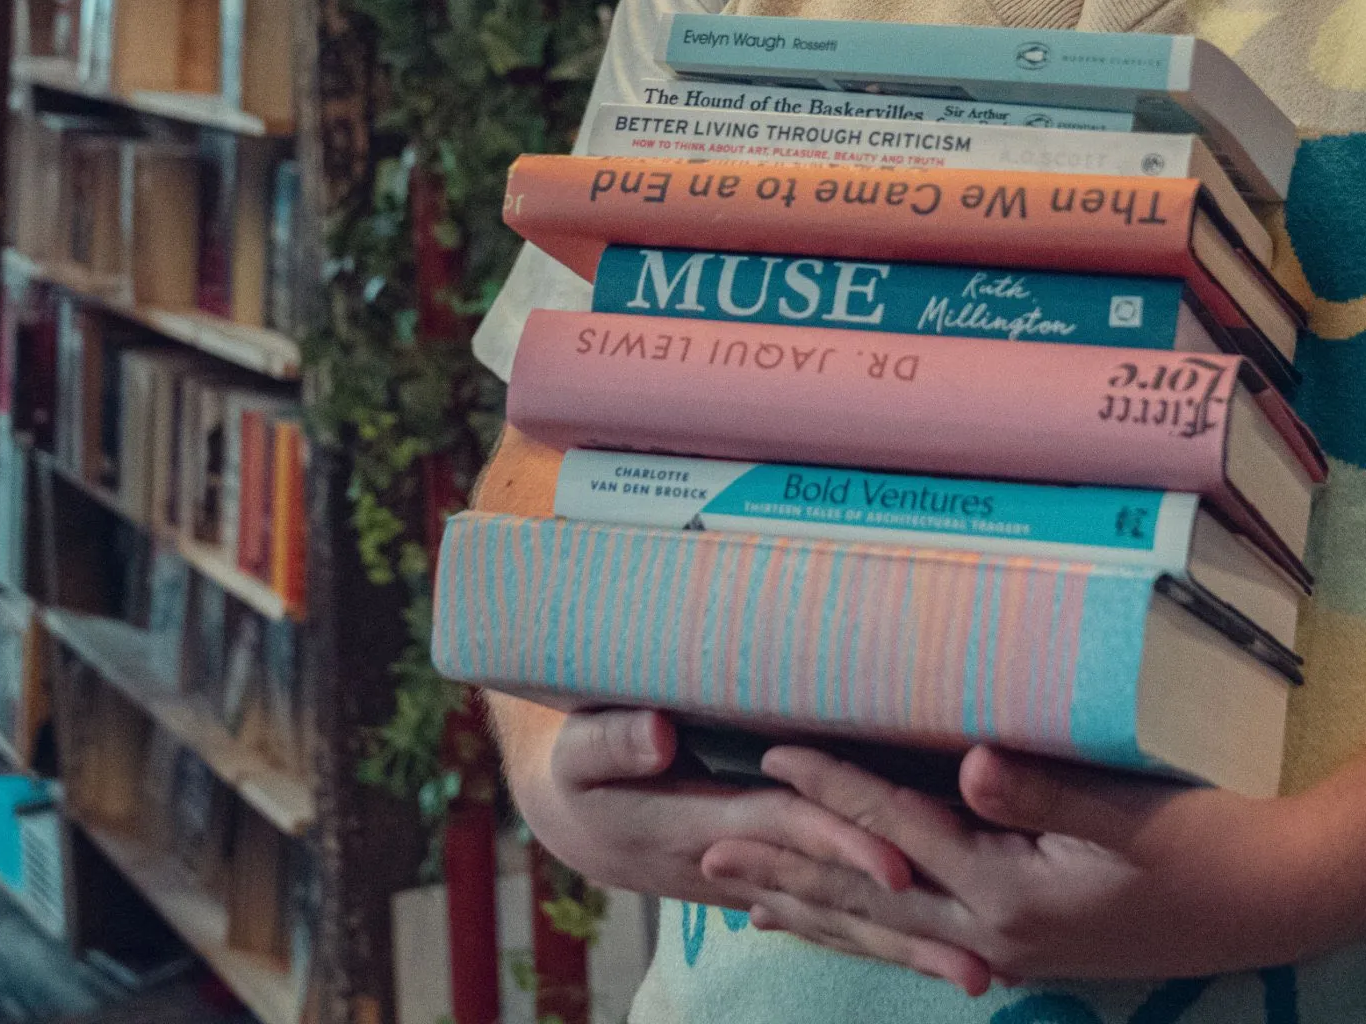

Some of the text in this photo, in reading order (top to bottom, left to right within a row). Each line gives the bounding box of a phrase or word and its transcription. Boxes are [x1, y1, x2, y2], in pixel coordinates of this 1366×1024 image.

[683, 29, 838, 53] Evelyn Waugh Rossetti
[644, 87, 679, 105] The
[683, 90, 746, 110] Hound
[750, 95, 772, 112] of
[773, 97, 803, 115] the
[809, 99, 924, 122] Baskervilles
[943, 104, 965, 118] Sir
[967, 107, 1011, 121] Arthur
[614, 116, 972, 153] BETTER LIVING THROUGH CRITICISM
[631, 138, 656, 149] HOW
[658, 140, 672, 150] TO
[674, 141, 706, 152] THINK
[708, 144, 745, 154] ABOUT
[833, 151, 877, 163] BEAUTY
[879, 154, 904, 165] AND
[907, 156, 946, 167] TRUTH
[589, 168, 1167, 225] Then We Came to an End
[626, 249, 892, 326] MUSE
[961, 272, 1031, 300] Ruth
[916, 295, 1077, 341] Millington
[575, 327, 921, 383] DR. JAQUI LEWIS
[1098, 393, 1221, 438] Fierce
[590, 479, 708, 501] VAN DEN BROECK
[614, 465, 690, 483] CHARLOTTE
[783, 473, 995, 517] Bold Ventures
